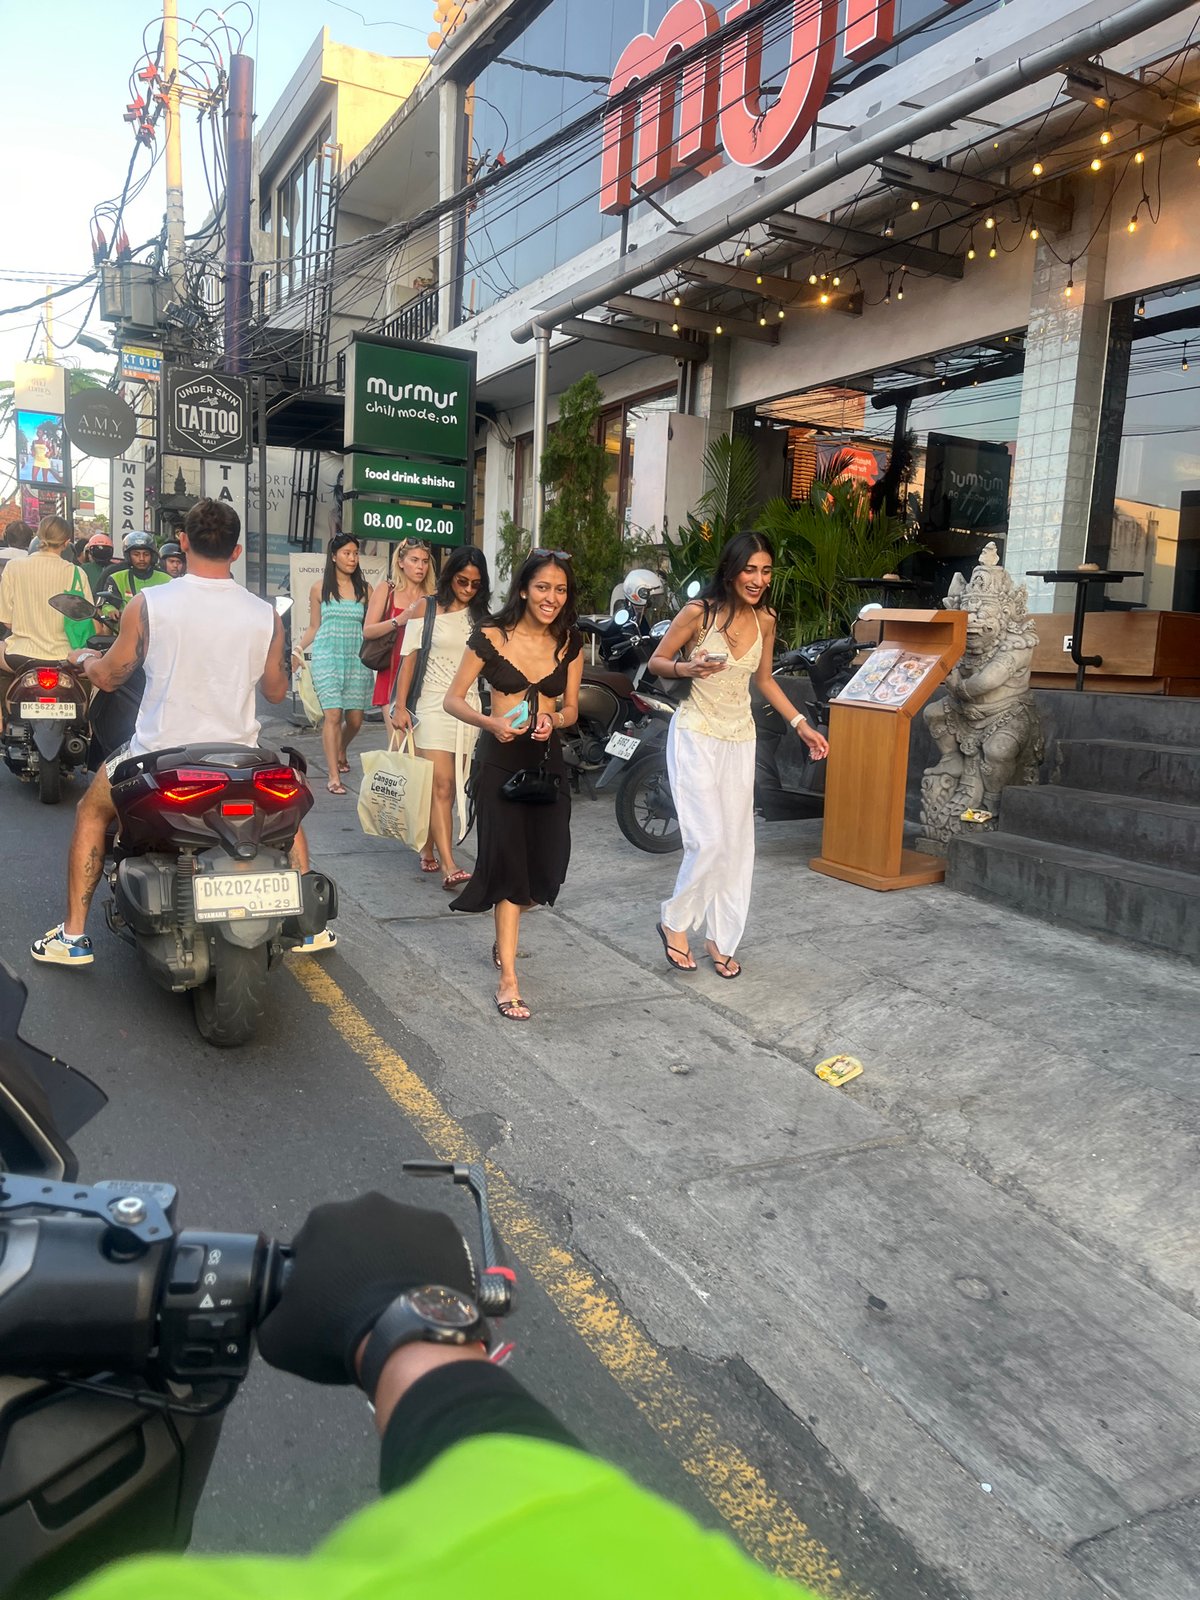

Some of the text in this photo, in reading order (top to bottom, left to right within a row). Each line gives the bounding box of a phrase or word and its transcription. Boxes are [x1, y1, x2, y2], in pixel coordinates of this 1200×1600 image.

[123, 353, 162, 368] KT 010
[178, 385, 239, 407] UNDER SKIN
[367, 377, 458, 409] murmur
[178, 403, 238, 435] TATTOO
[365, 401, 458, 424] chill mode: on
[78, 415, 122, 432] AMY
[198, 430, 221, 439] Studio
[365, 468, 456, 489] food drink shisha
[121, 463, 136, 540] MASSA
[363, 512, 402, 530] 08.00
[415, 517, 454, 535] 02.00
[371, 783, 398, 797] Leather
[373, 772, 398, 787] Canggu
